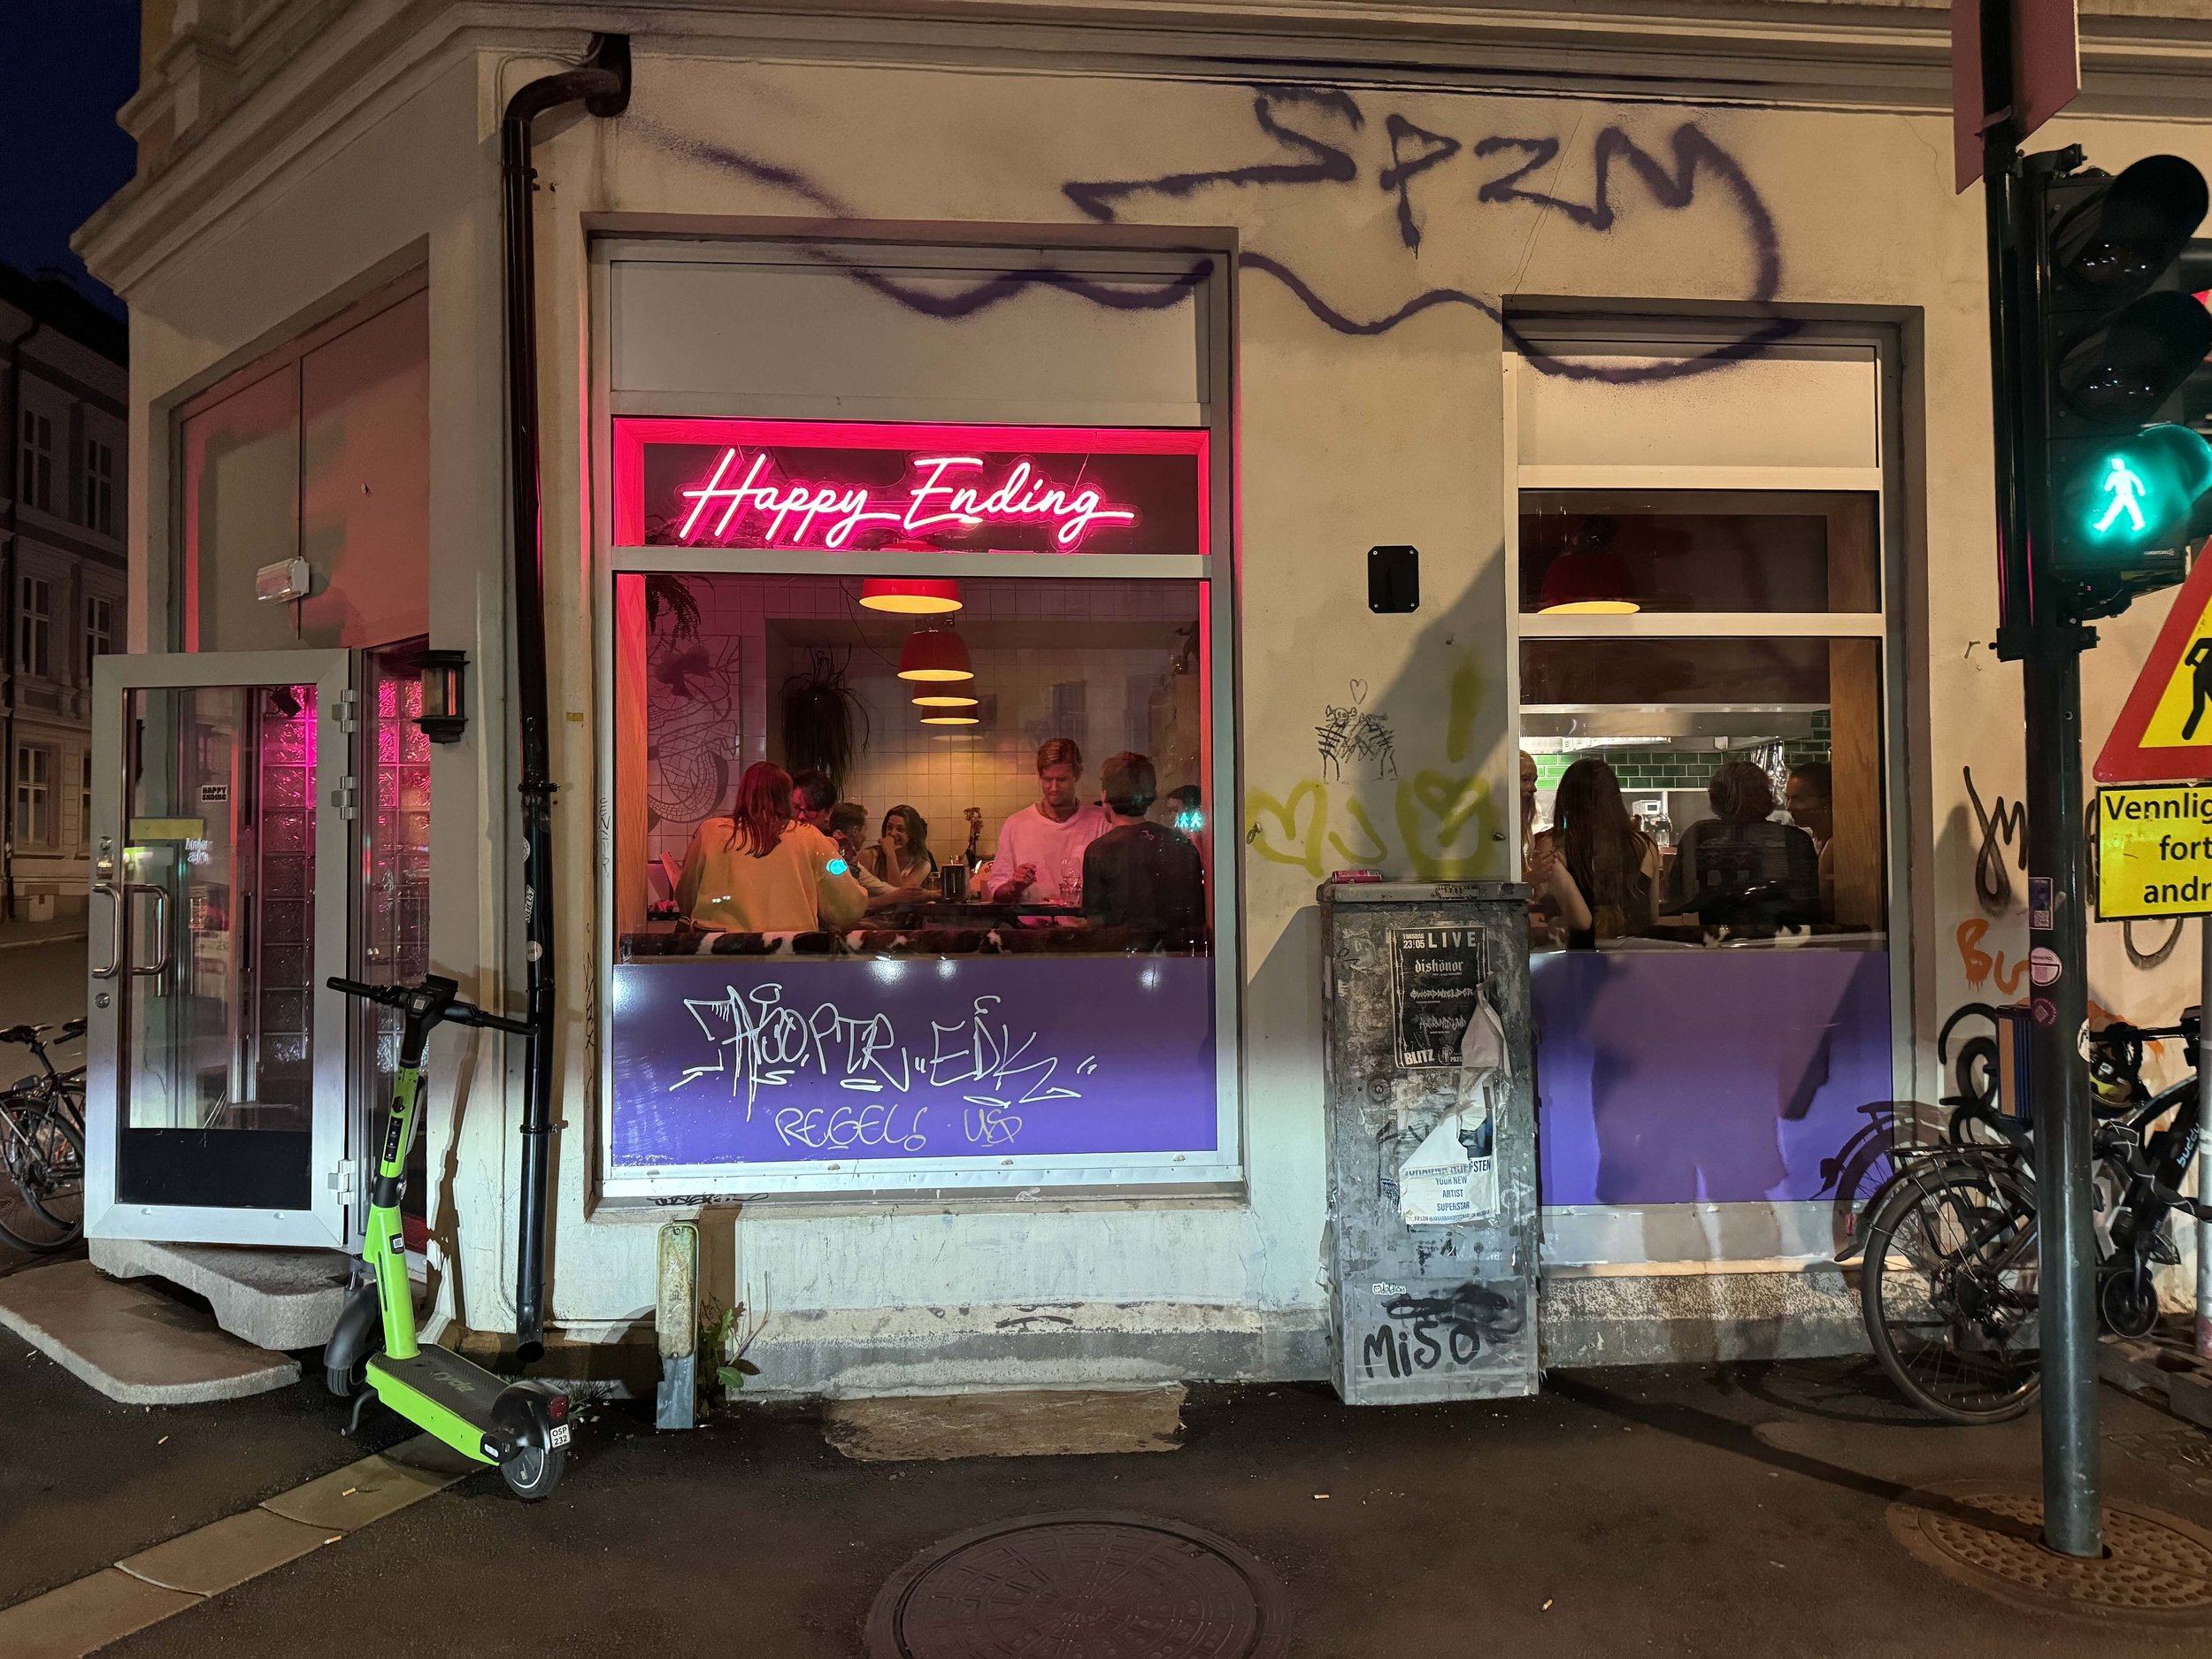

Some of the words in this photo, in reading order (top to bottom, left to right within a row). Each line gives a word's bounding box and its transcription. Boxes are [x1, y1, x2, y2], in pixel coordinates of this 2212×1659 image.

[683, 448, 901, 549] Happy
[902, 457, 1136, 546] Ending
[202, 786, 227, 795] HAPPY
[2105, 792, 2212, 825] Vennlig
[2160, 834, 2212, 861] fort
[1428, 932, 1477, 949] LIVE
[1415, 958, 1464, 973] dishönor
[1403, 1048, 1434, 1065] BLITZ
[1435, 1177, 1452, 1186] YOUR
[1453, 1176, 1468, 1185] NEW
[1442, 1188, 1463, 1198] ARTIST
[1436, 1201, 1471, 1211] SUPERSTAR
[551, 1427, 567, 1437] OSP
[554, 1435, 568, 1446] 232
